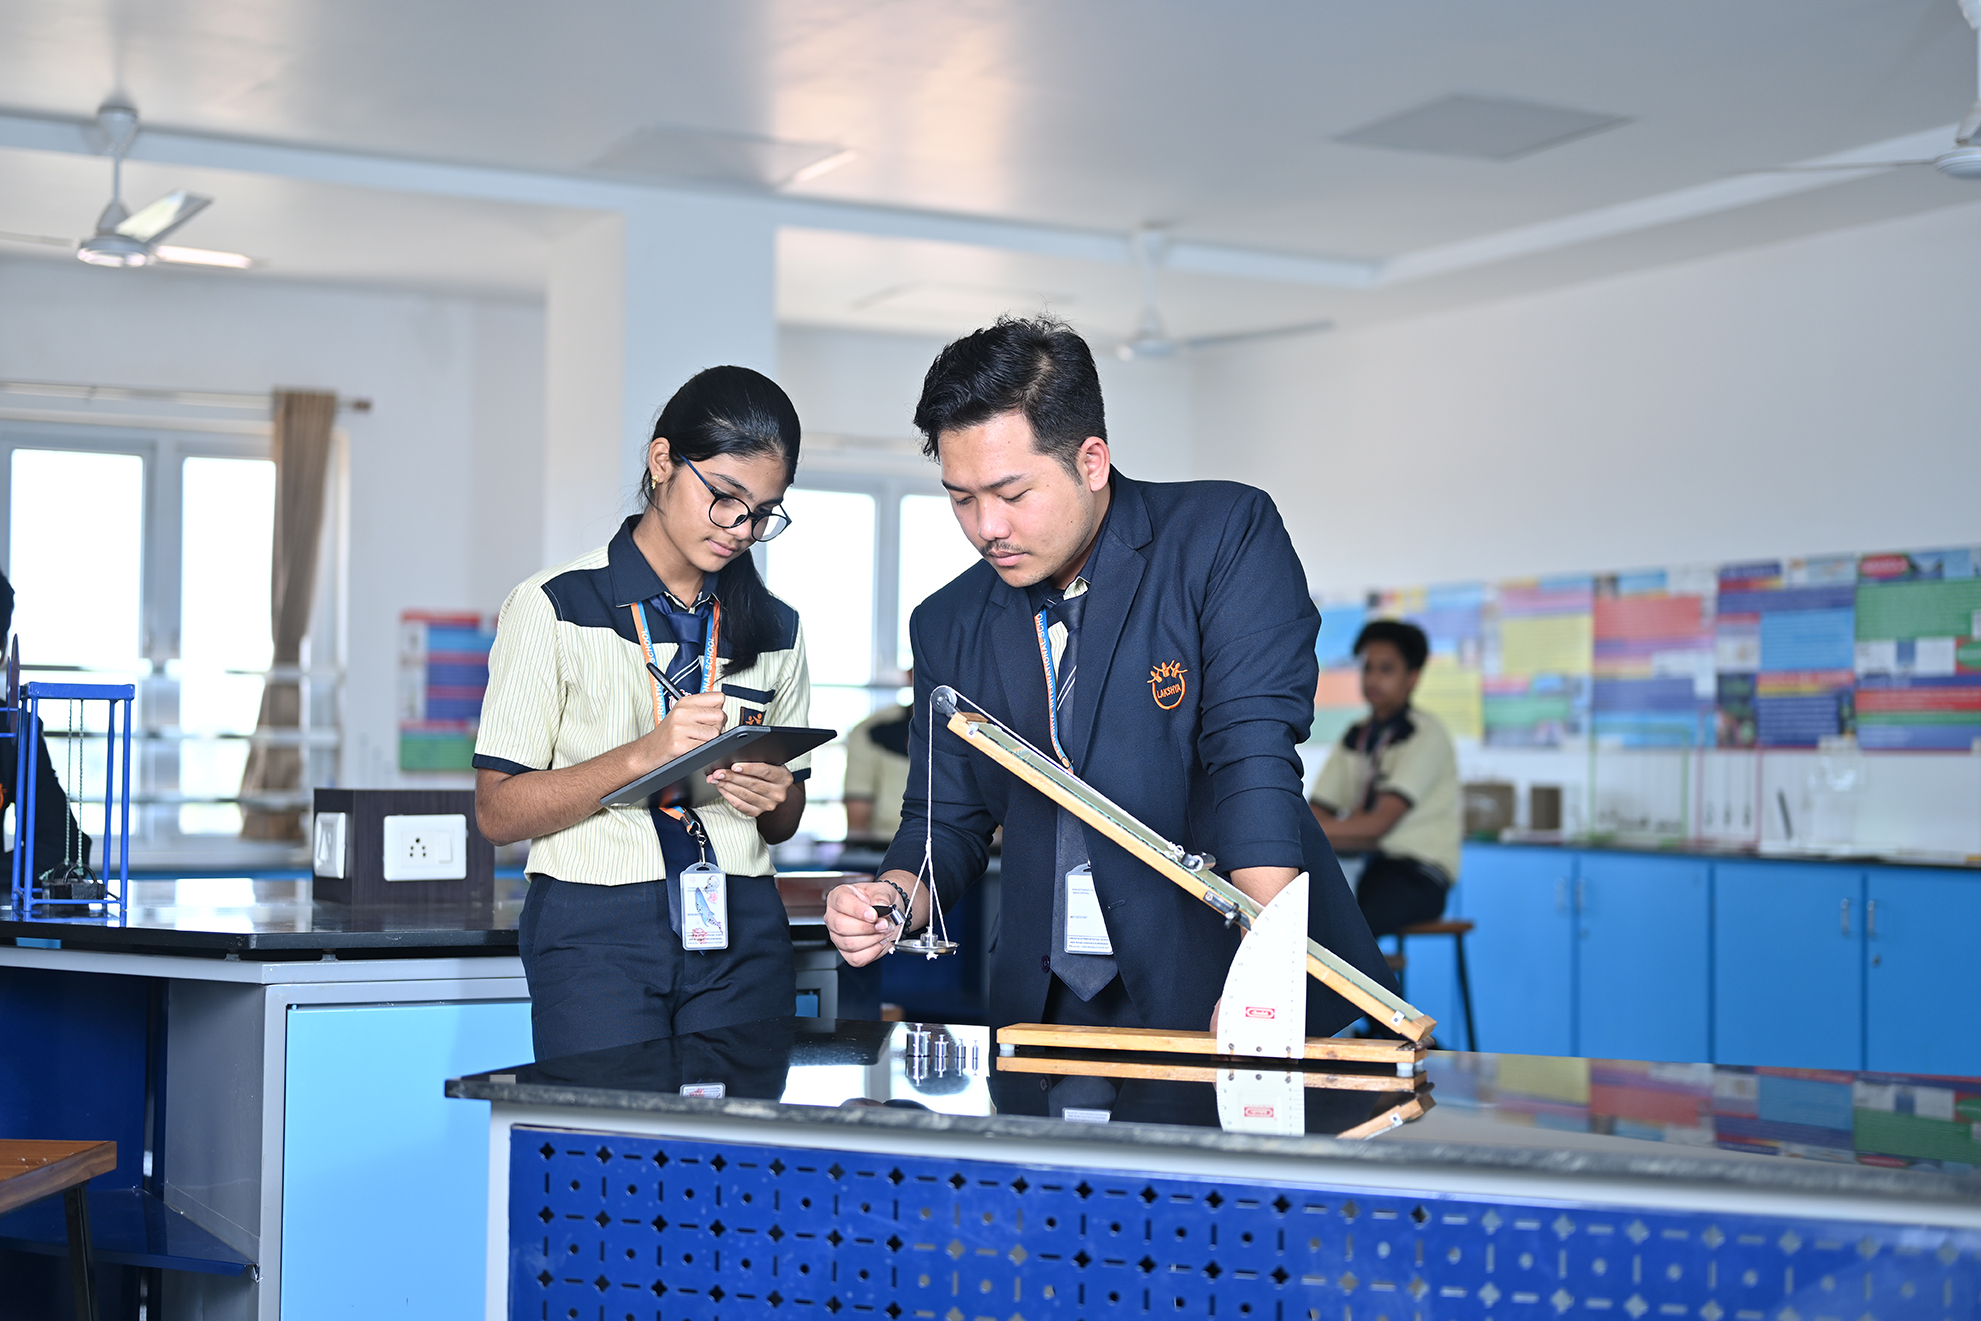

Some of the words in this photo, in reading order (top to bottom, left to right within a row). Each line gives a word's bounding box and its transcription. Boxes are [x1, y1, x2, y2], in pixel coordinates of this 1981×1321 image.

[1036, 613, 1045, 638] SCHO
[641, 628, 656, 663] SCHOOL
[702, 673, 711, 693] ONAL
[1040, 638, 1054, 708] INTERNATIONAL
[1157, 683, 1182, 699] LAKSHYA
